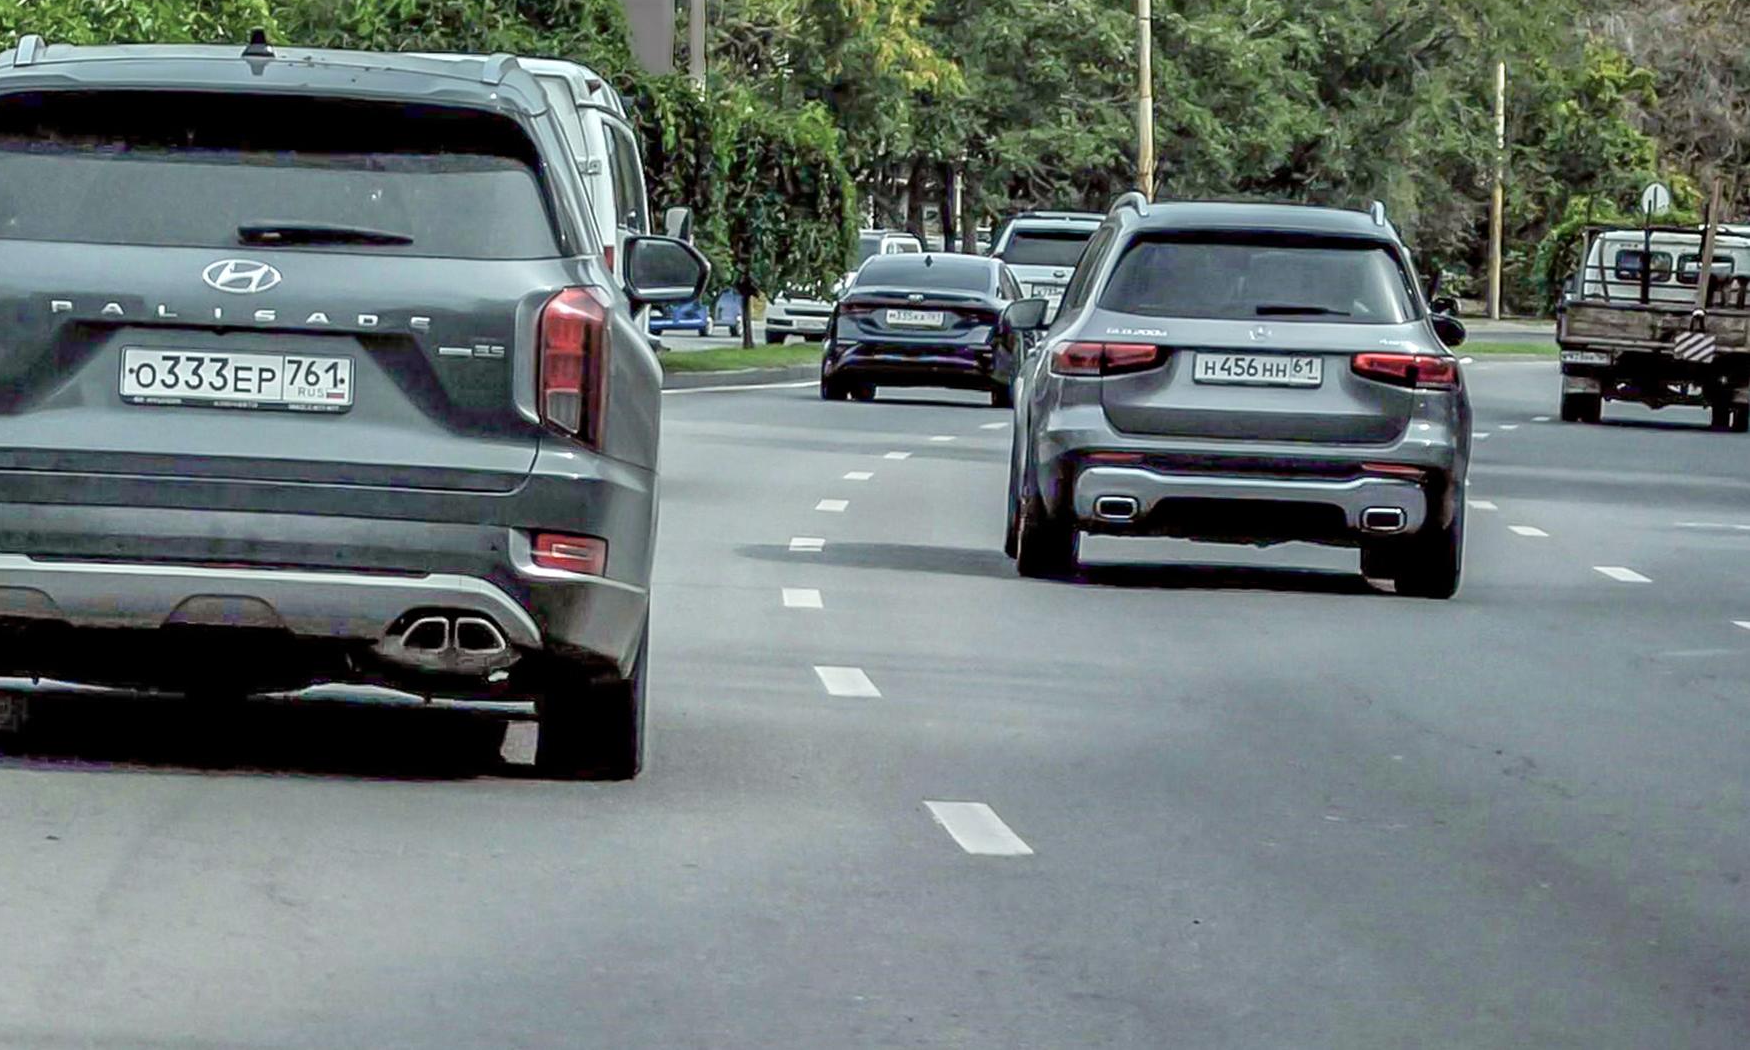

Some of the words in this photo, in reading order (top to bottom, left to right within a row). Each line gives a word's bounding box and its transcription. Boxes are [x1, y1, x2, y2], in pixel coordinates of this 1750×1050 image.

[51, 299, 432, 331] PALISADE
[287, 359, 339, 389] 761
[297, 387, 325, 399] RUS
